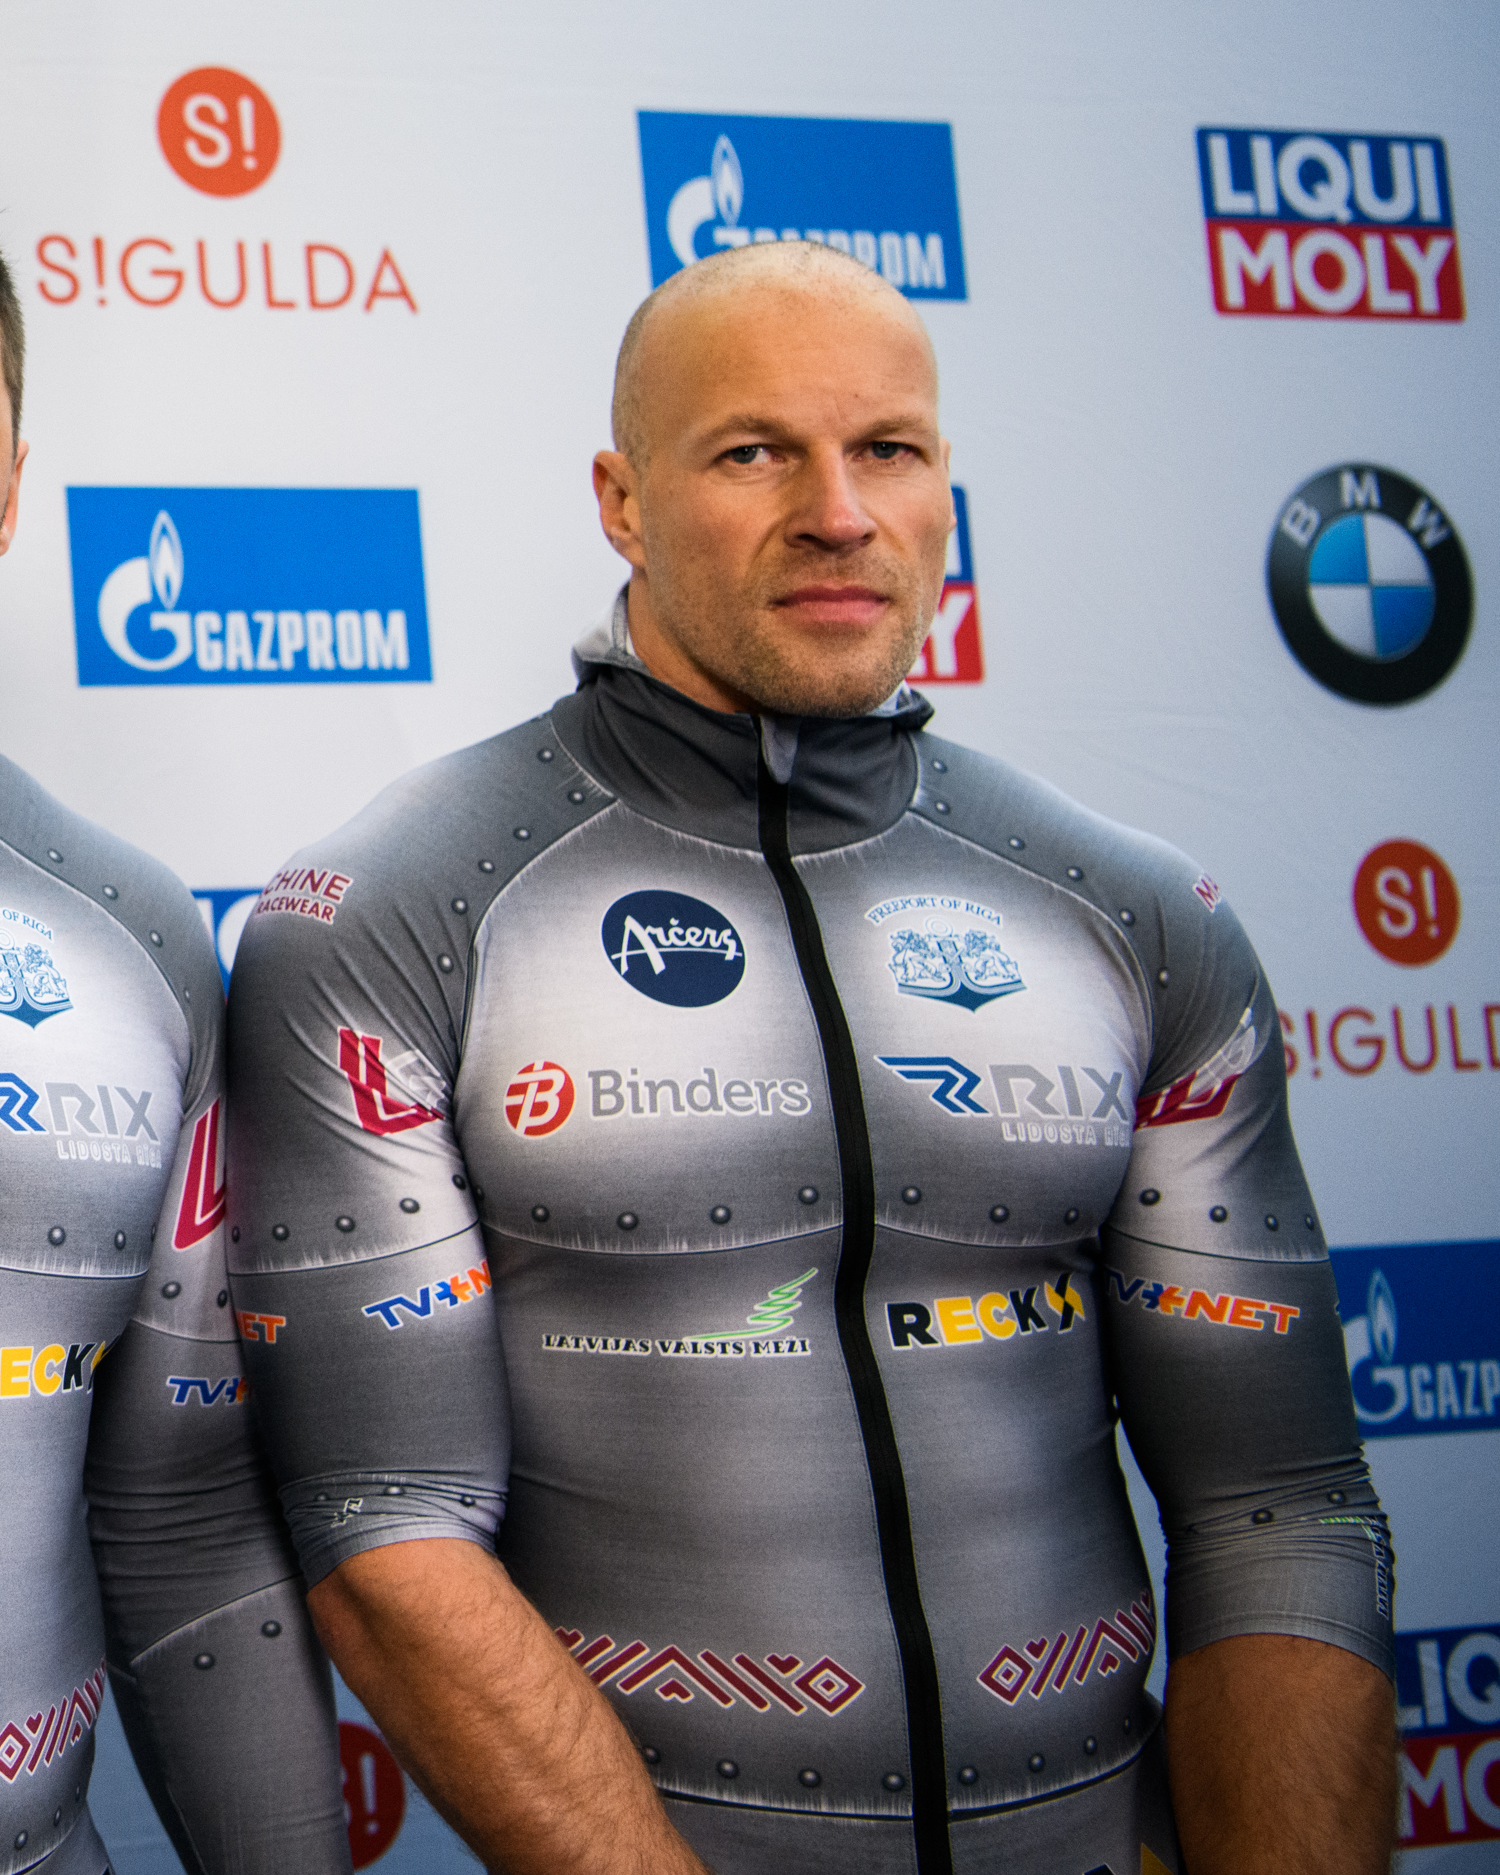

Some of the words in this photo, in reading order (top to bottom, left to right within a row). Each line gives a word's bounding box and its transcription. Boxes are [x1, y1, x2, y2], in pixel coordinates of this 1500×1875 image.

[182, 93, 258, 171] S!
[1207, 133, 1443, 224] LIQUI
[35, 234, 419, 314] S!GULDA
[1218, 228, 1453, 315] MOLY
[1281, 471, 1447, 550] BMW
[195, 609, 409, 671] GAZPROM
[2, 908, 20, 922] OF
[22, 914, 52, 941] RIGA
[867, 896, 937, 923] FREEPORT
[940, 897, 961, 910] OF
[965, 902, 1001, 926] RIGA
[46, 1081, 160, 1144] RIX
[587, 1066, 811, 1118] Binders
[987, 1063, 1130, 1123] RIX
[56, 1138, 132, 1164] LIDOSTA
[1001, 1122, 1098, 1146] LIDOSTA
[543, 1334, 651, 1353] LATVIJAS
[656, 1339, 745, 1356] VALSTS
[751, 1335, 811, 1355] MEŽI
